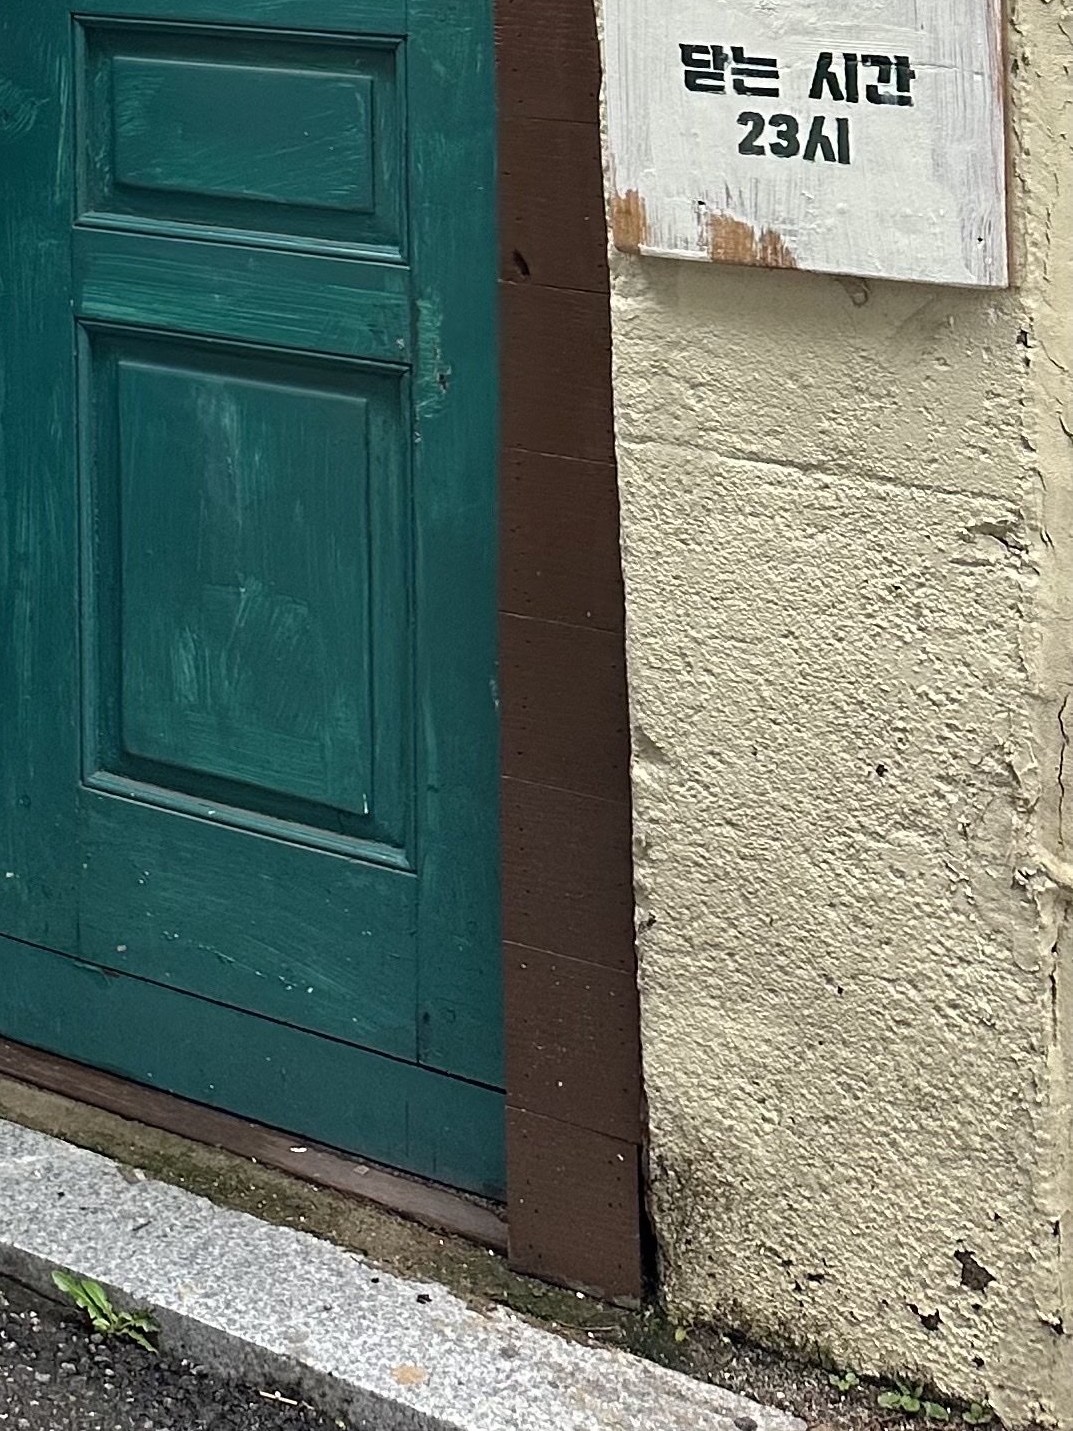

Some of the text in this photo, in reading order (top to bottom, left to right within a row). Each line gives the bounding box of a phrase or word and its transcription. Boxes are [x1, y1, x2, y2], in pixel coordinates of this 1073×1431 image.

[678, 42, 917, 107] 닫는 시간
[736, 110, 852, 165] 23시
